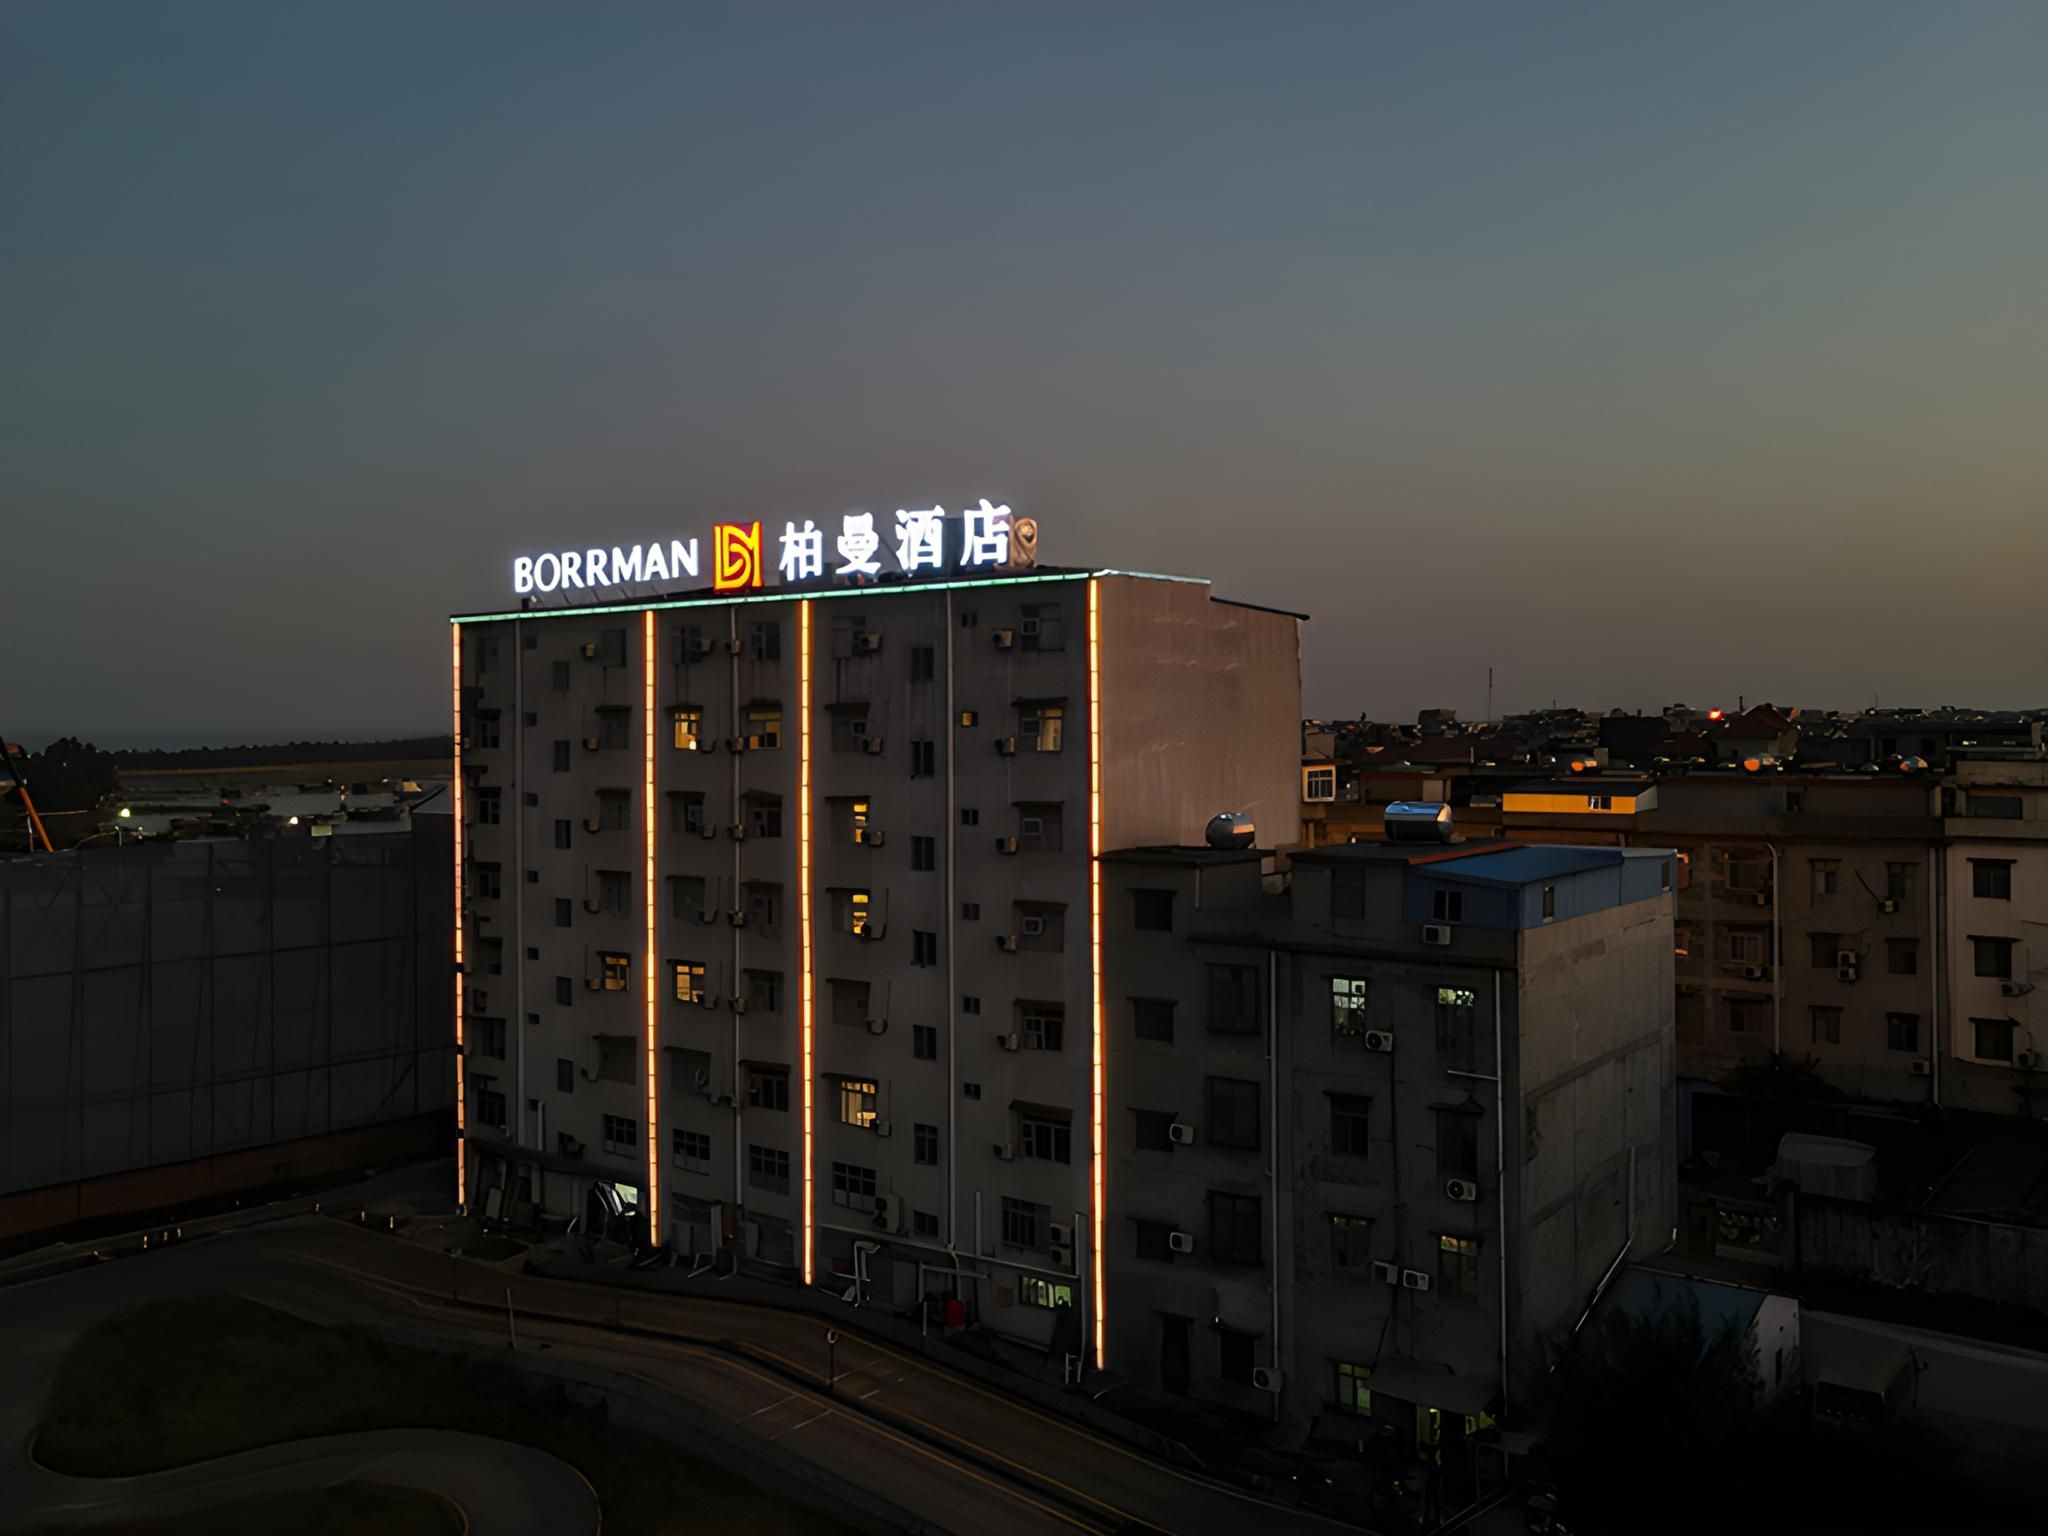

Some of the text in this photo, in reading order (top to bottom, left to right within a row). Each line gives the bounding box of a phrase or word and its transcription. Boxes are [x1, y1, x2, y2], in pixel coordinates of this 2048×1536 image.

[514, 538, 699, 593] BORRMAN
[779, 498, 1011, 581] 柏曼酒店
